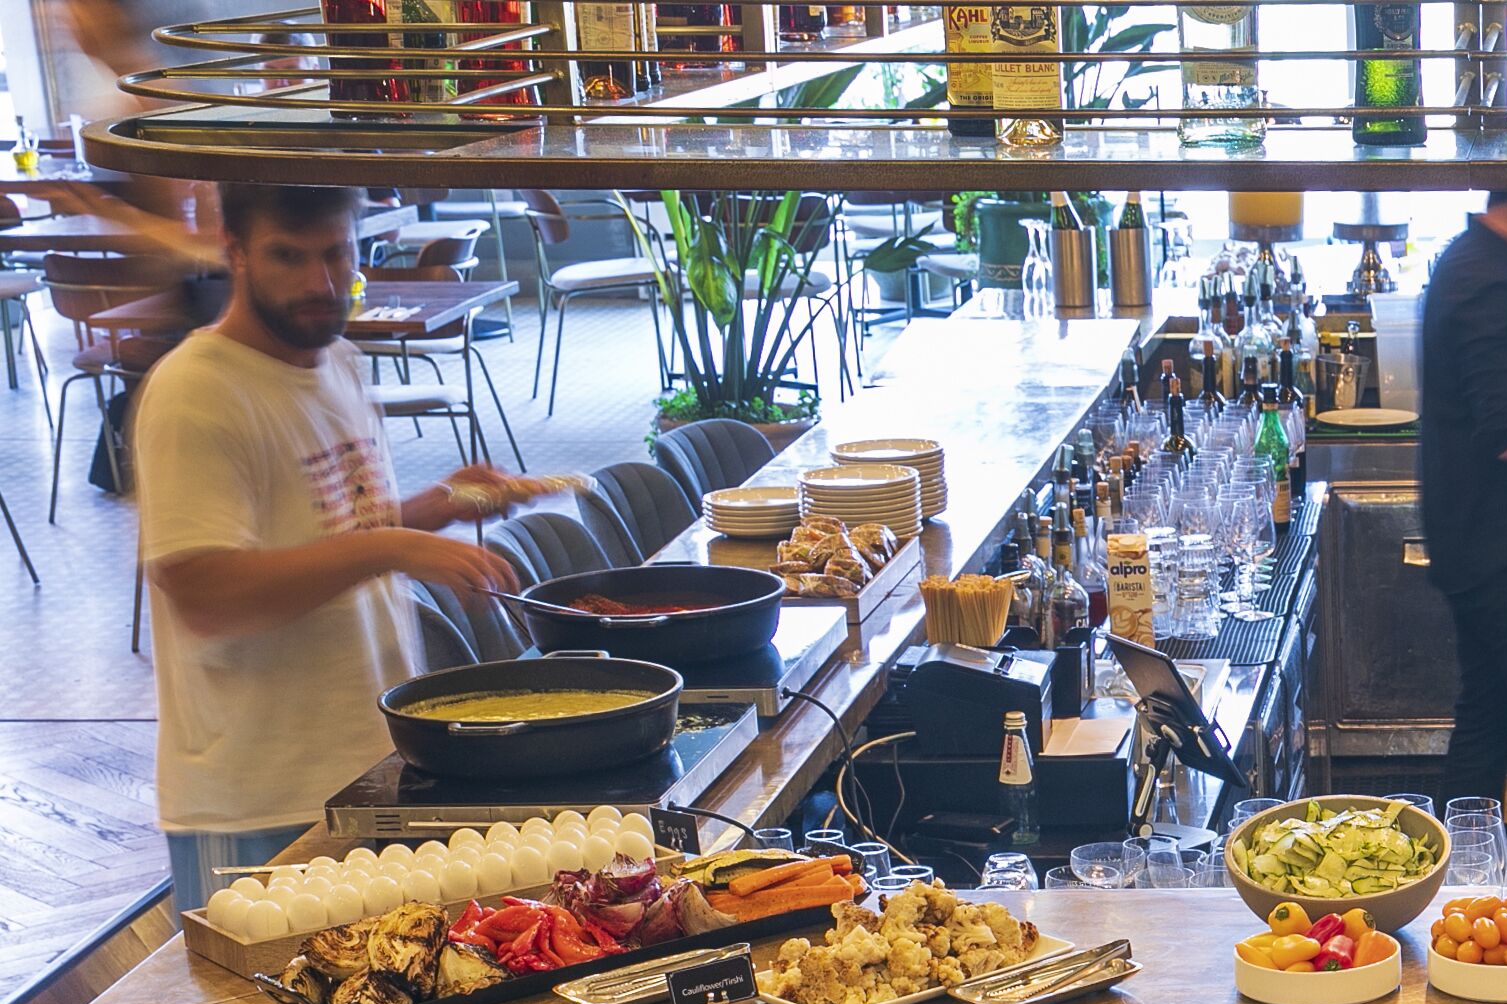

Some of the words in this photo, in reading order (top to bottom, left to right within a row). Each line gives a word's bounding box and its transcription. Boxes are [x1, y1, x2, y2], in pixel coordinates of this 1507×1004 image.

[1025, 63, 1055, 73] BLANC
[1110, 561, 1147, 578] alpro
[682, 974, 744, 996] Cauliflower/Tirshi
